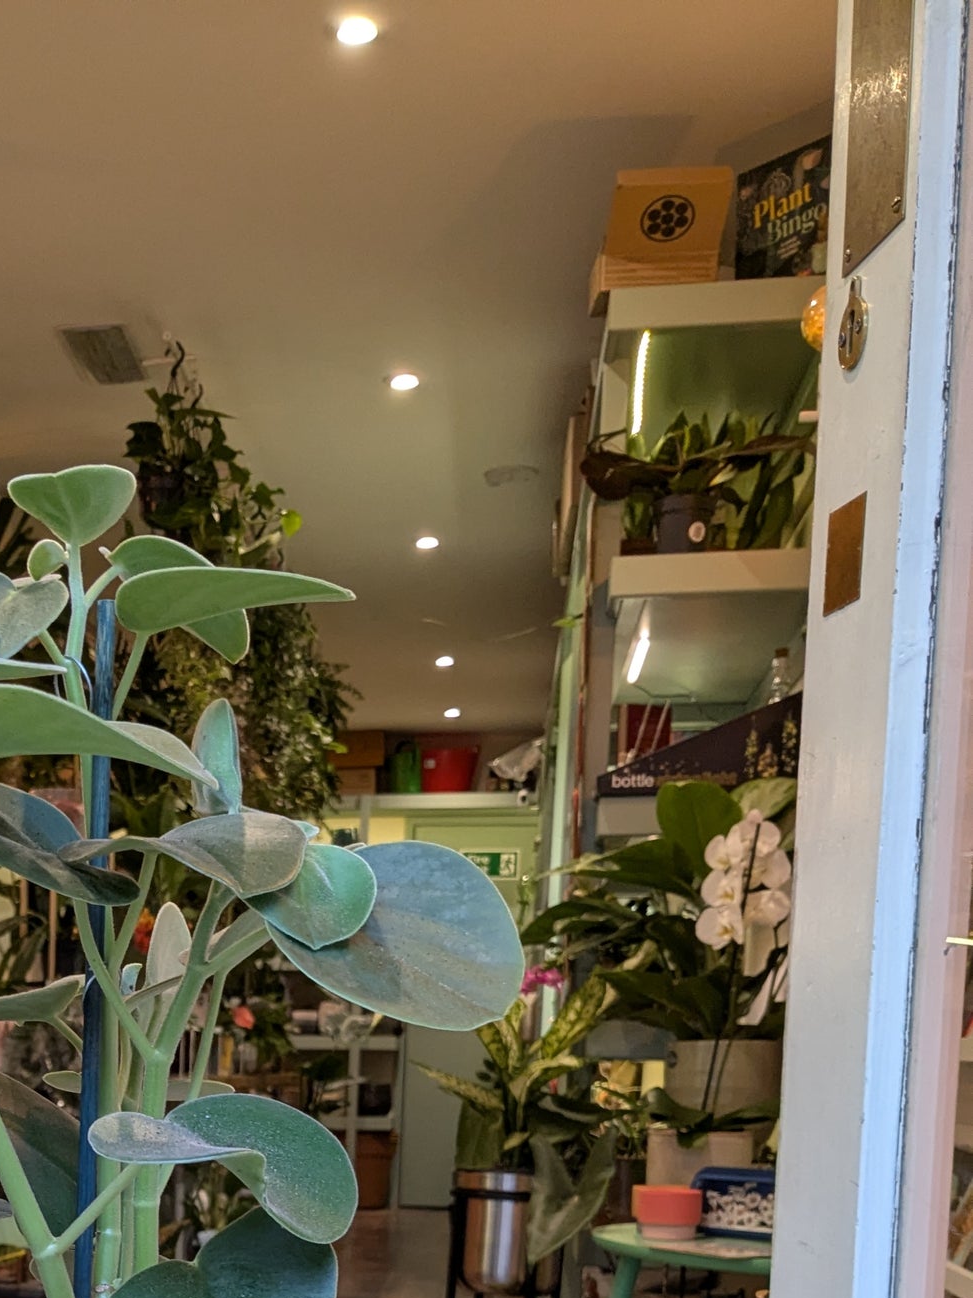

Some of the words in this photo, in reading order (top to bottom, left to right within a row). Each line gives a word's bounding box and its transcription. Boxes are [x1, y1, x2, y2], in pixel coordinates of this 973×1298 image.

[753, 182, 812, 230] Plant
[767, 203, 827, 244] Bingo
[611, 772, 655, 789] bottle
